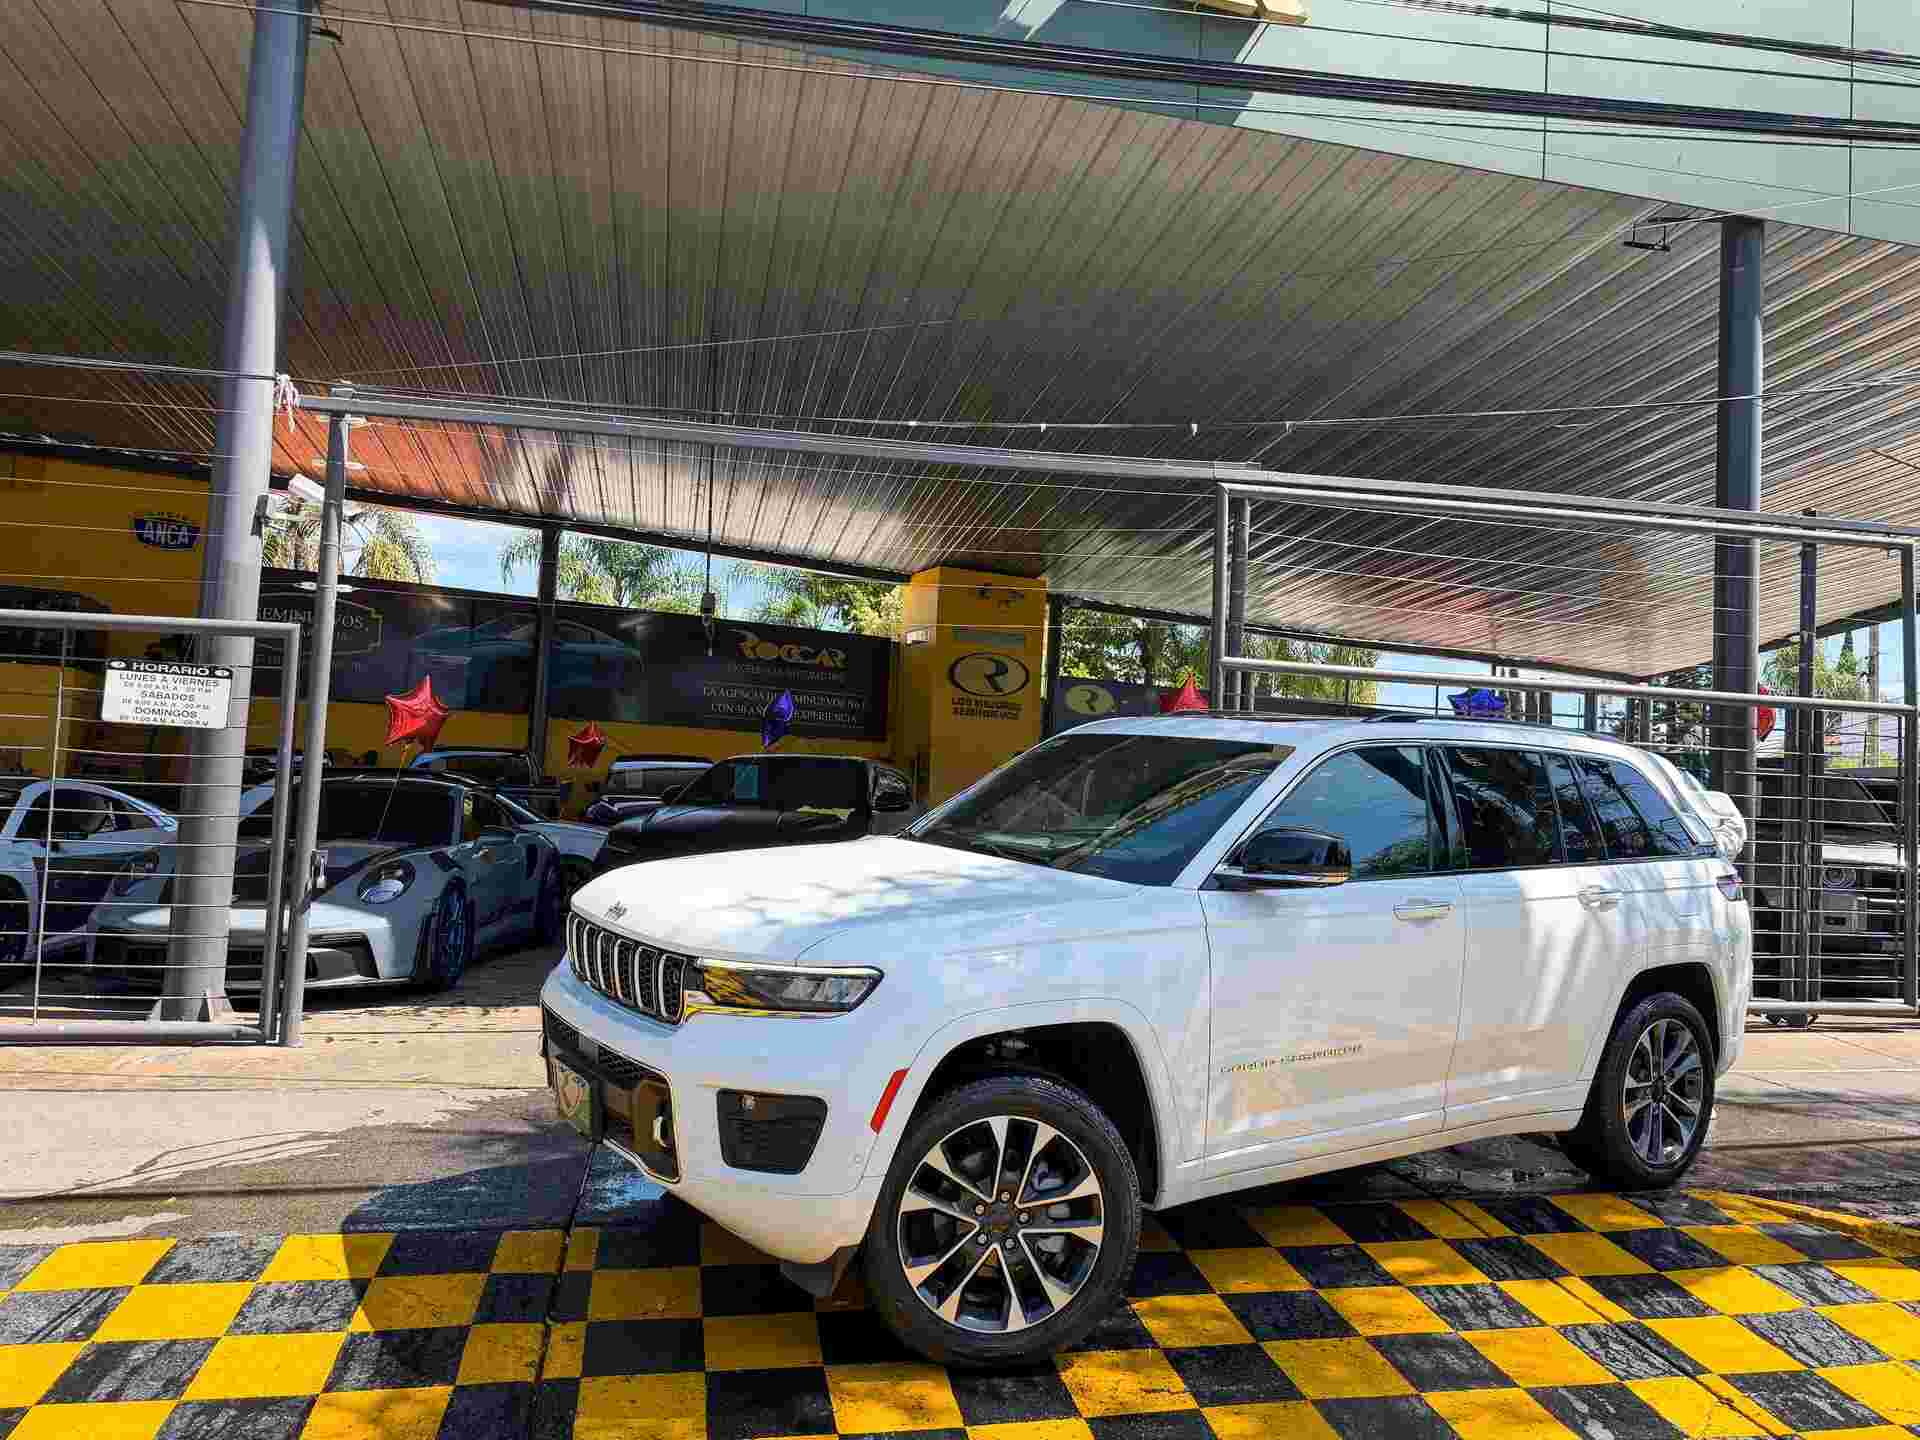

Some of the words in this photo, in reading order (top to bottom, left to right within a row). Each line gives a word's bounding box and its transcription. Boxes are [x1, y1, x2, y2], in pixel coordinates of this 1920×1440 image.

[731, 630, 849, 670] ROCCAR
[132, 661, 210, 676] HORARIO
[119, 672, 157, 682] LUNES
[160, 675, 168, 683] A
[171, 676, 219, 688] VIERNES
[134, 706, 199, 719] DOMINGOS
